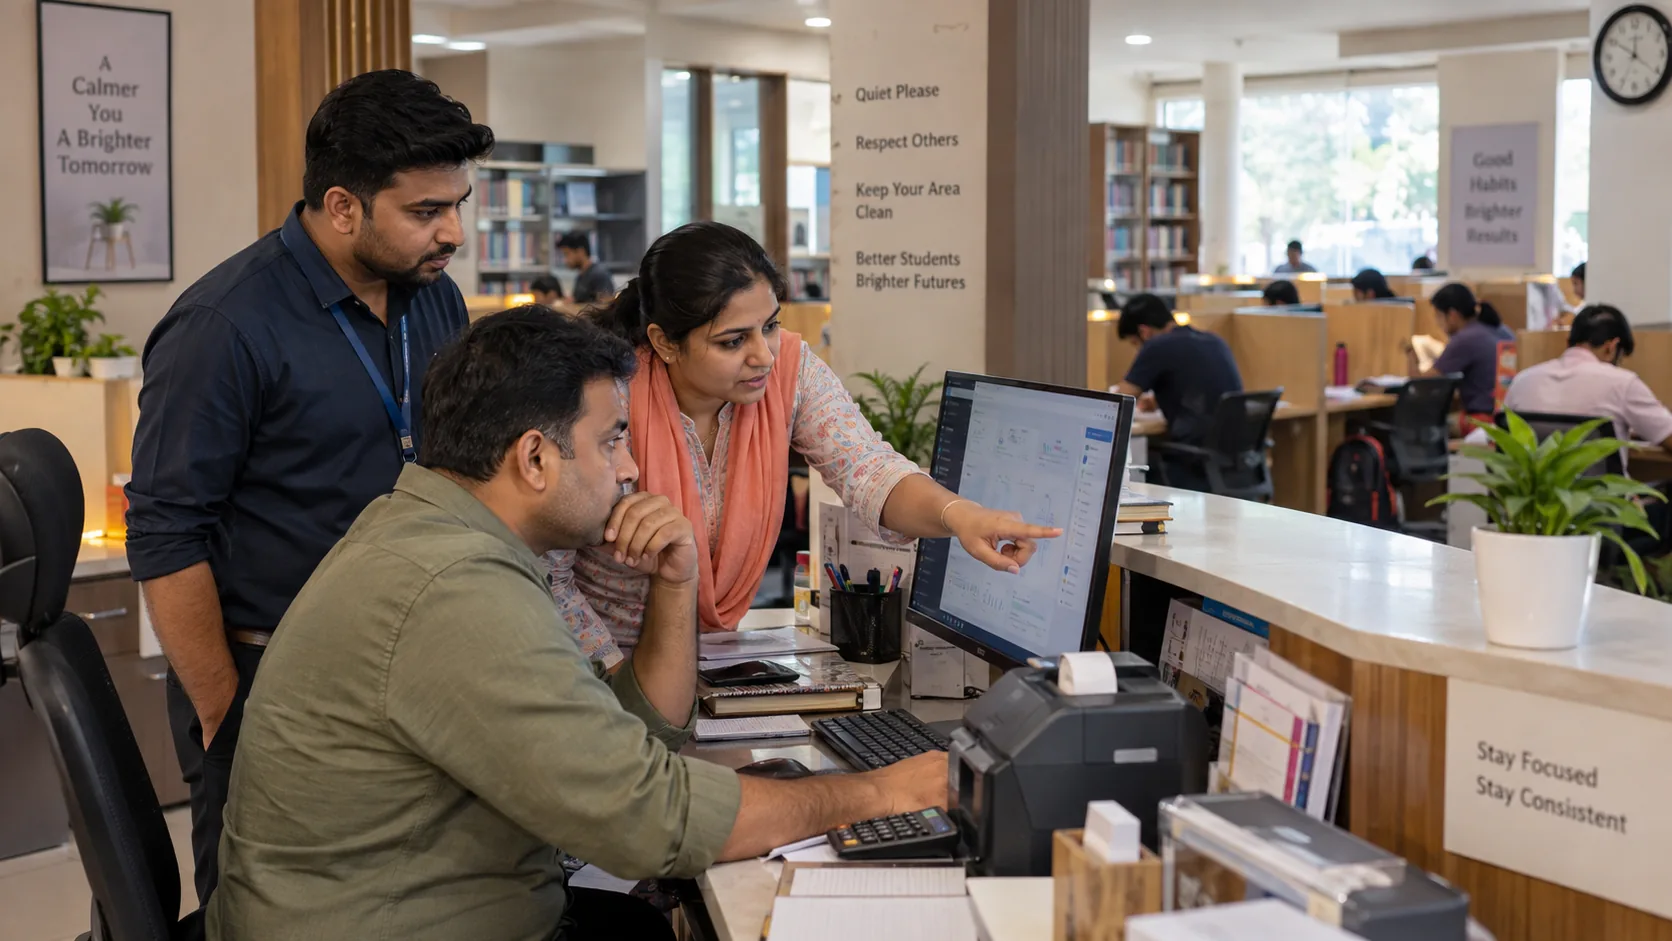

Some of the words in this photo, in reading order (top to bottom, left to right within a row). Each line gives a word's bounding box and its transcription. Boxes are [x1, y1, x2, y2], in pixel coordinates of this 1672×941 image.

[99, 55, 112, 72] A
[72, 76, 139, 98] Calmer
[855, 86, 892, 103] Quiet
[896, 84, 940, 99] Please
[88, 103, 123, 123] You
[57, 128, 72, 148] A
[77, 128, 151, 153] Brighter
[855, 135, 908, 153] Respect
[911, 132, 959, 148] Others
[57, 154, 153, 175] Tomorrow
[855, 183, 889, 199] Keep
[892, 182, 924, 196] Your
[928, 181, 961, 196] Area
[855, 204, 893, 219] Clean
[855, 250, 897, 266] Better
[900, 250, 961, 266] Students
[855, 272, 910, 292] Brighter
[913, 273, 966, 290] Futures
[1477, 740, 1516, 771] Stay
[1521, 750, 1599, 788] Focused
[1476, 774, 1515, 807] Stay
